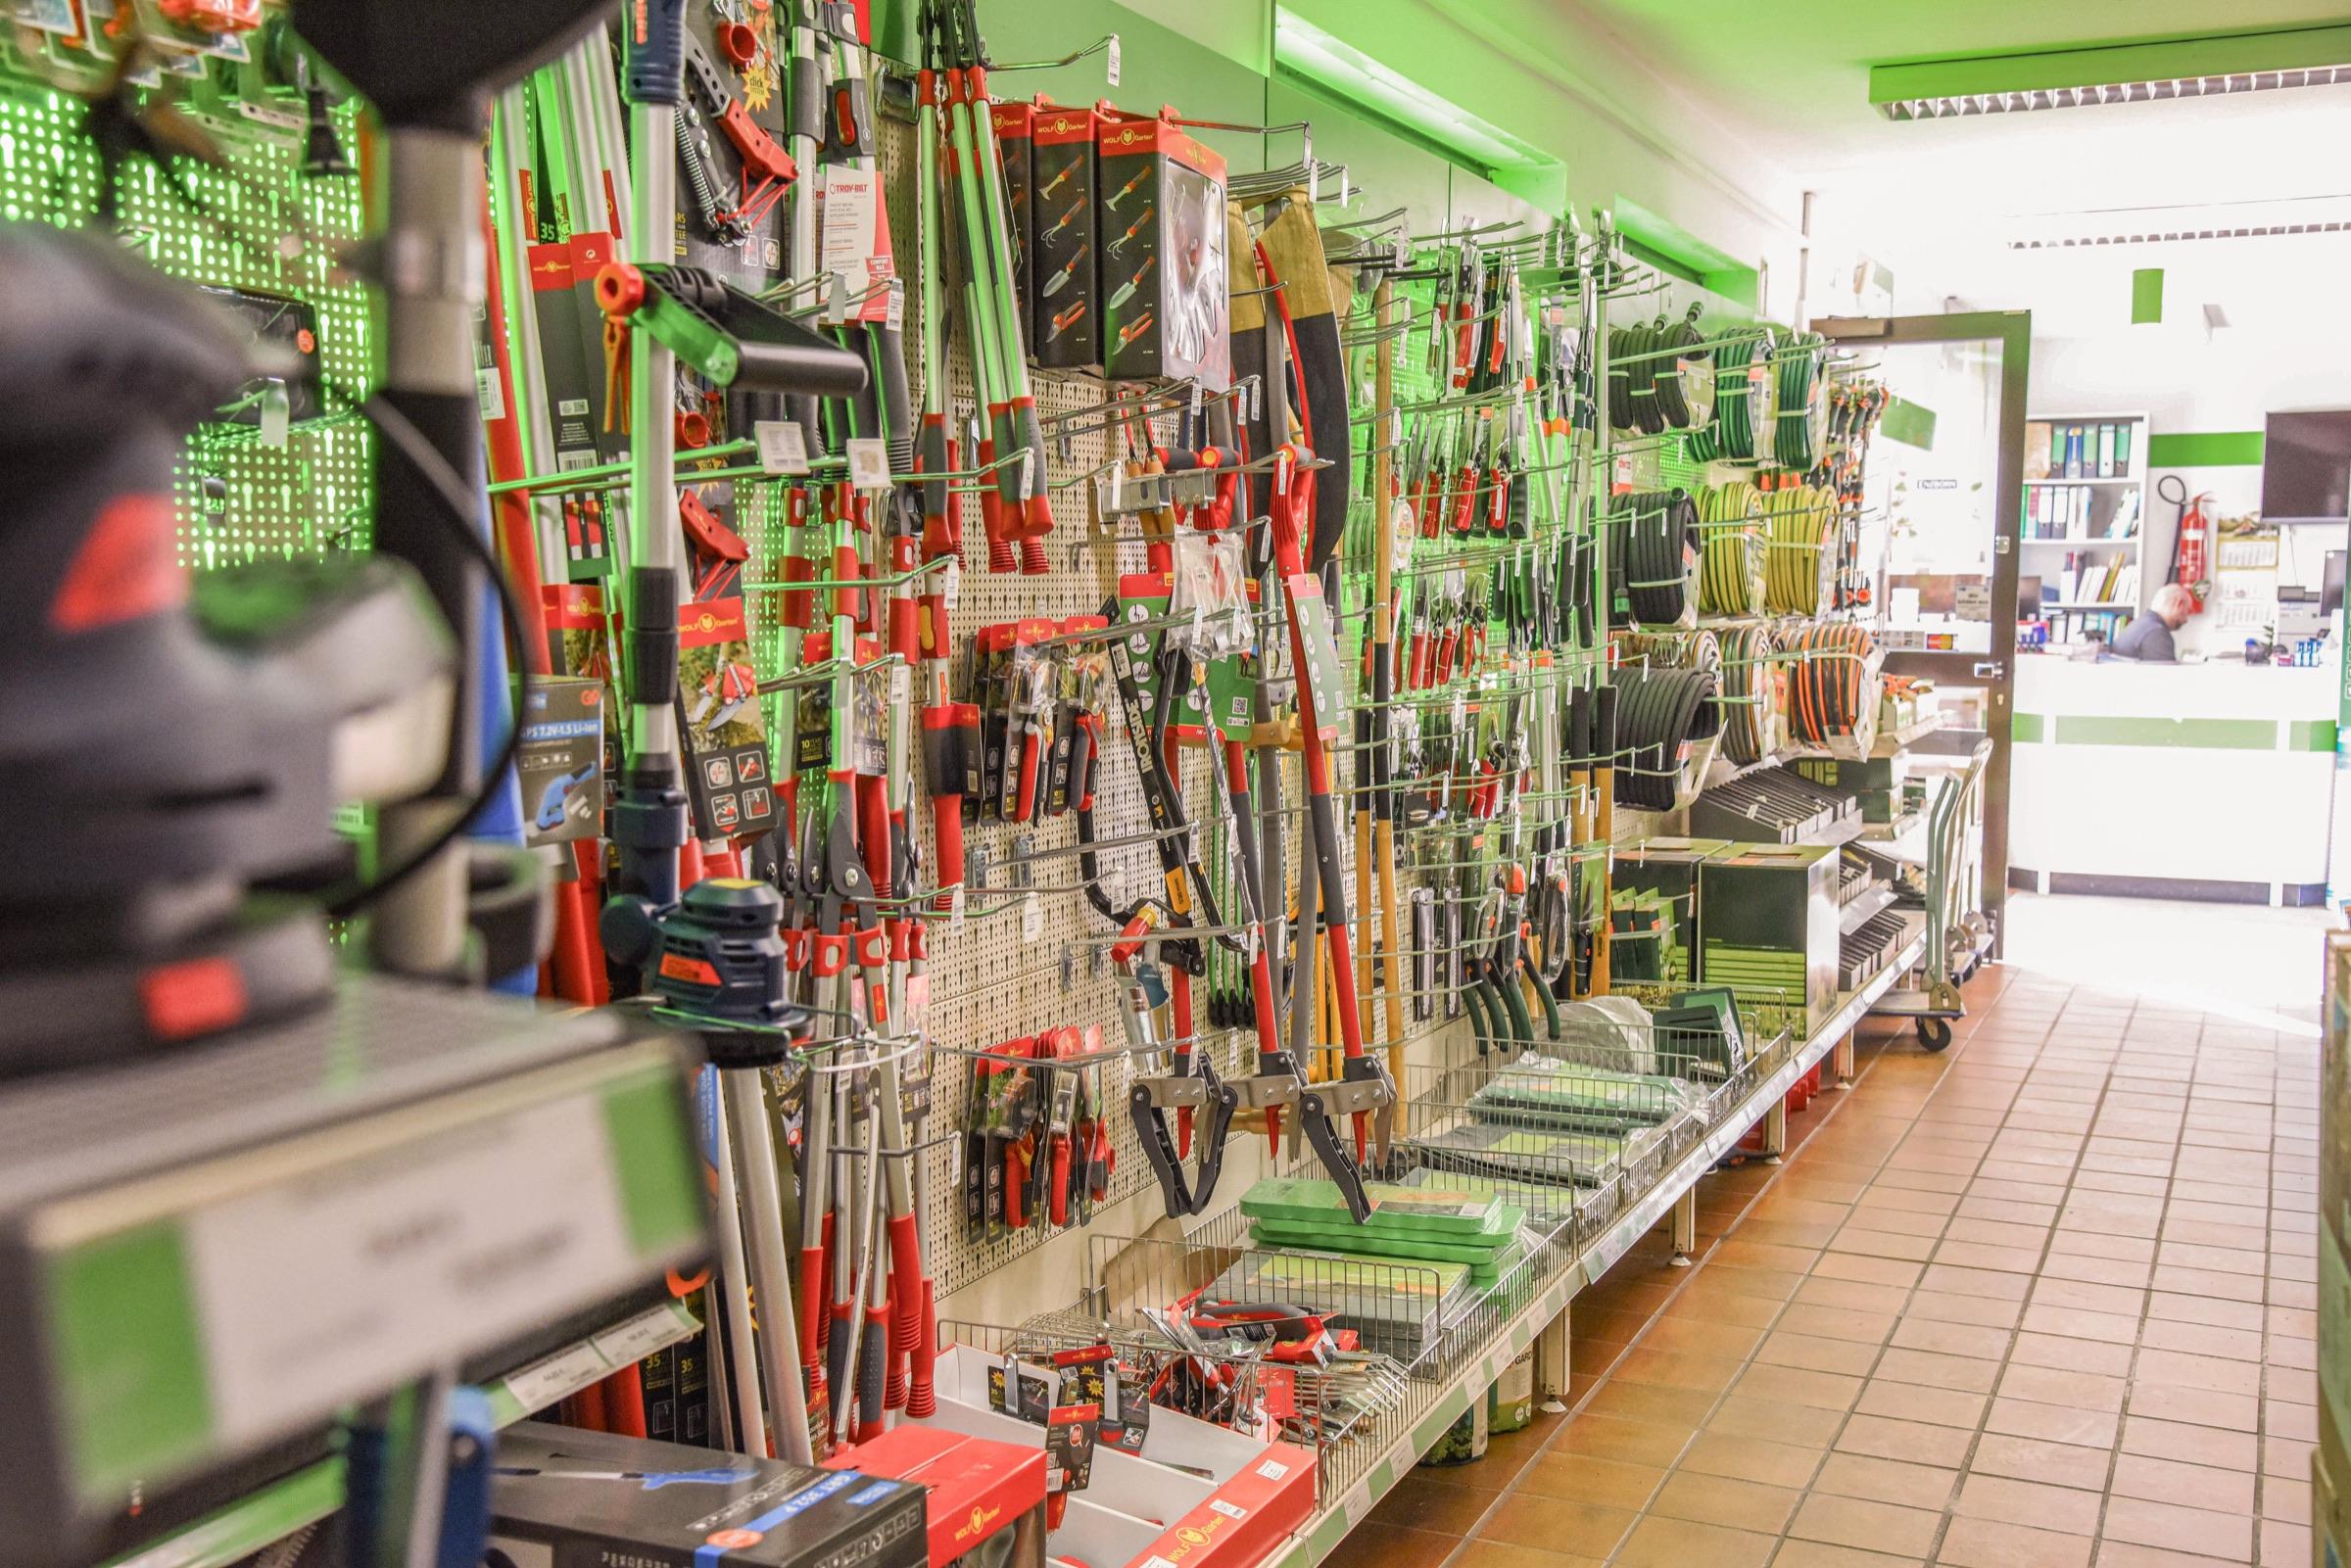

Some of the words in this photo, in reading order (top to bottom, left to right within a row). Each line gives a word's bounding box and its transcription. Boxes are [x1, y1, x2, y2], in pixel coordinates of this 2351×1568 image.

[749, 75, 764, 88] click
[836, 183, 868, 195] TROY-BILT
[540, 221, 555, 241] 35
[678, 623, 697, 633] WOLF
[1125, 697, 1154, 775] IRONSIDE
[801, 739, 811, 749] 10
[681, 1358, 694, 1374] 35
[1167, 1543, 1192, 1562] WOLF
[1201, 1513, 1227, 1534] Garten
